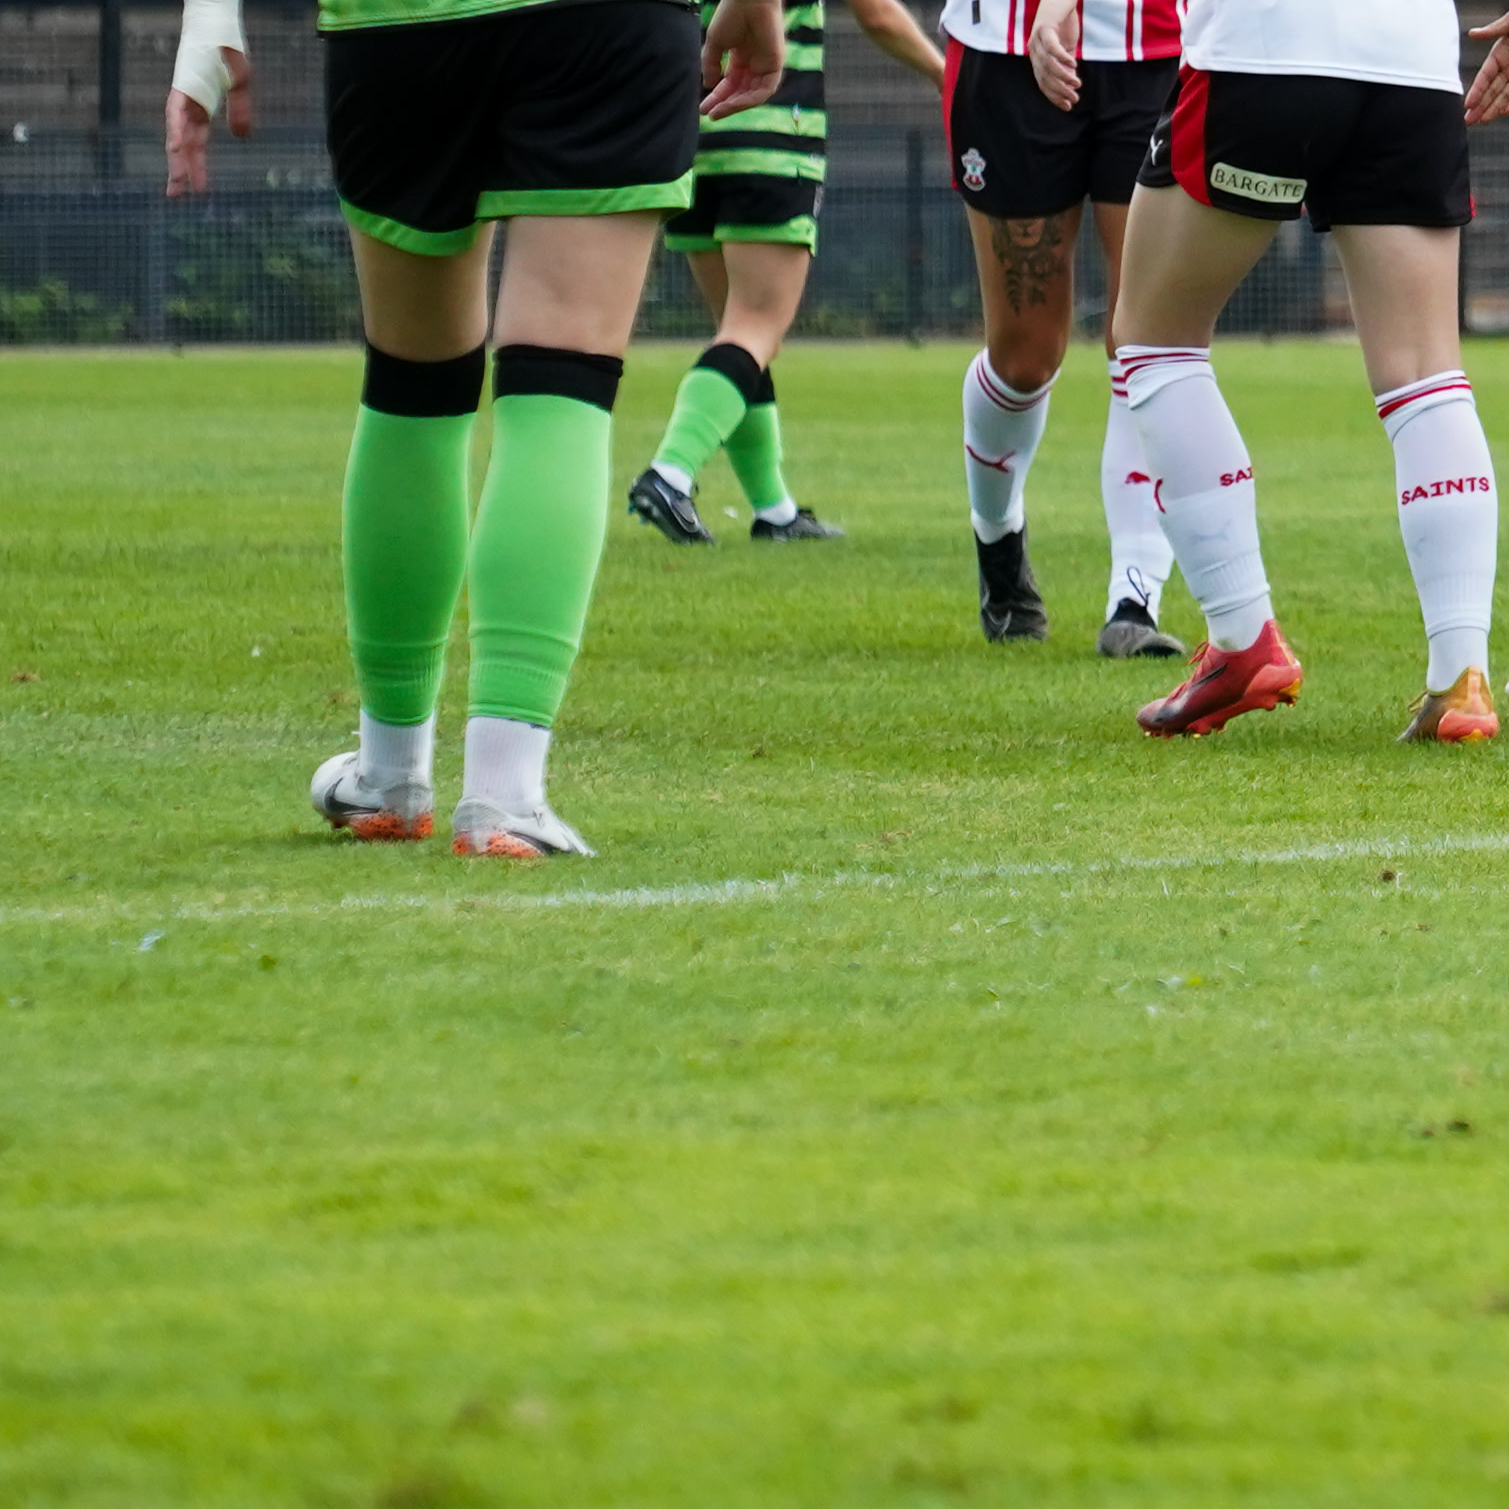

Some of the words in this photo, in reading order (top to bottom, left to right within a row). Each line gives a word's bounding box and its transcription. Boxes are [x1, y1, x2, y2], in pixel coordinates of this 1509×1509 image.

[1214, 169, 1304, 197] BARGATE
[1220, 467, 1253, 487] SAI
[1401, 477, 1489, 505] SAINTS
